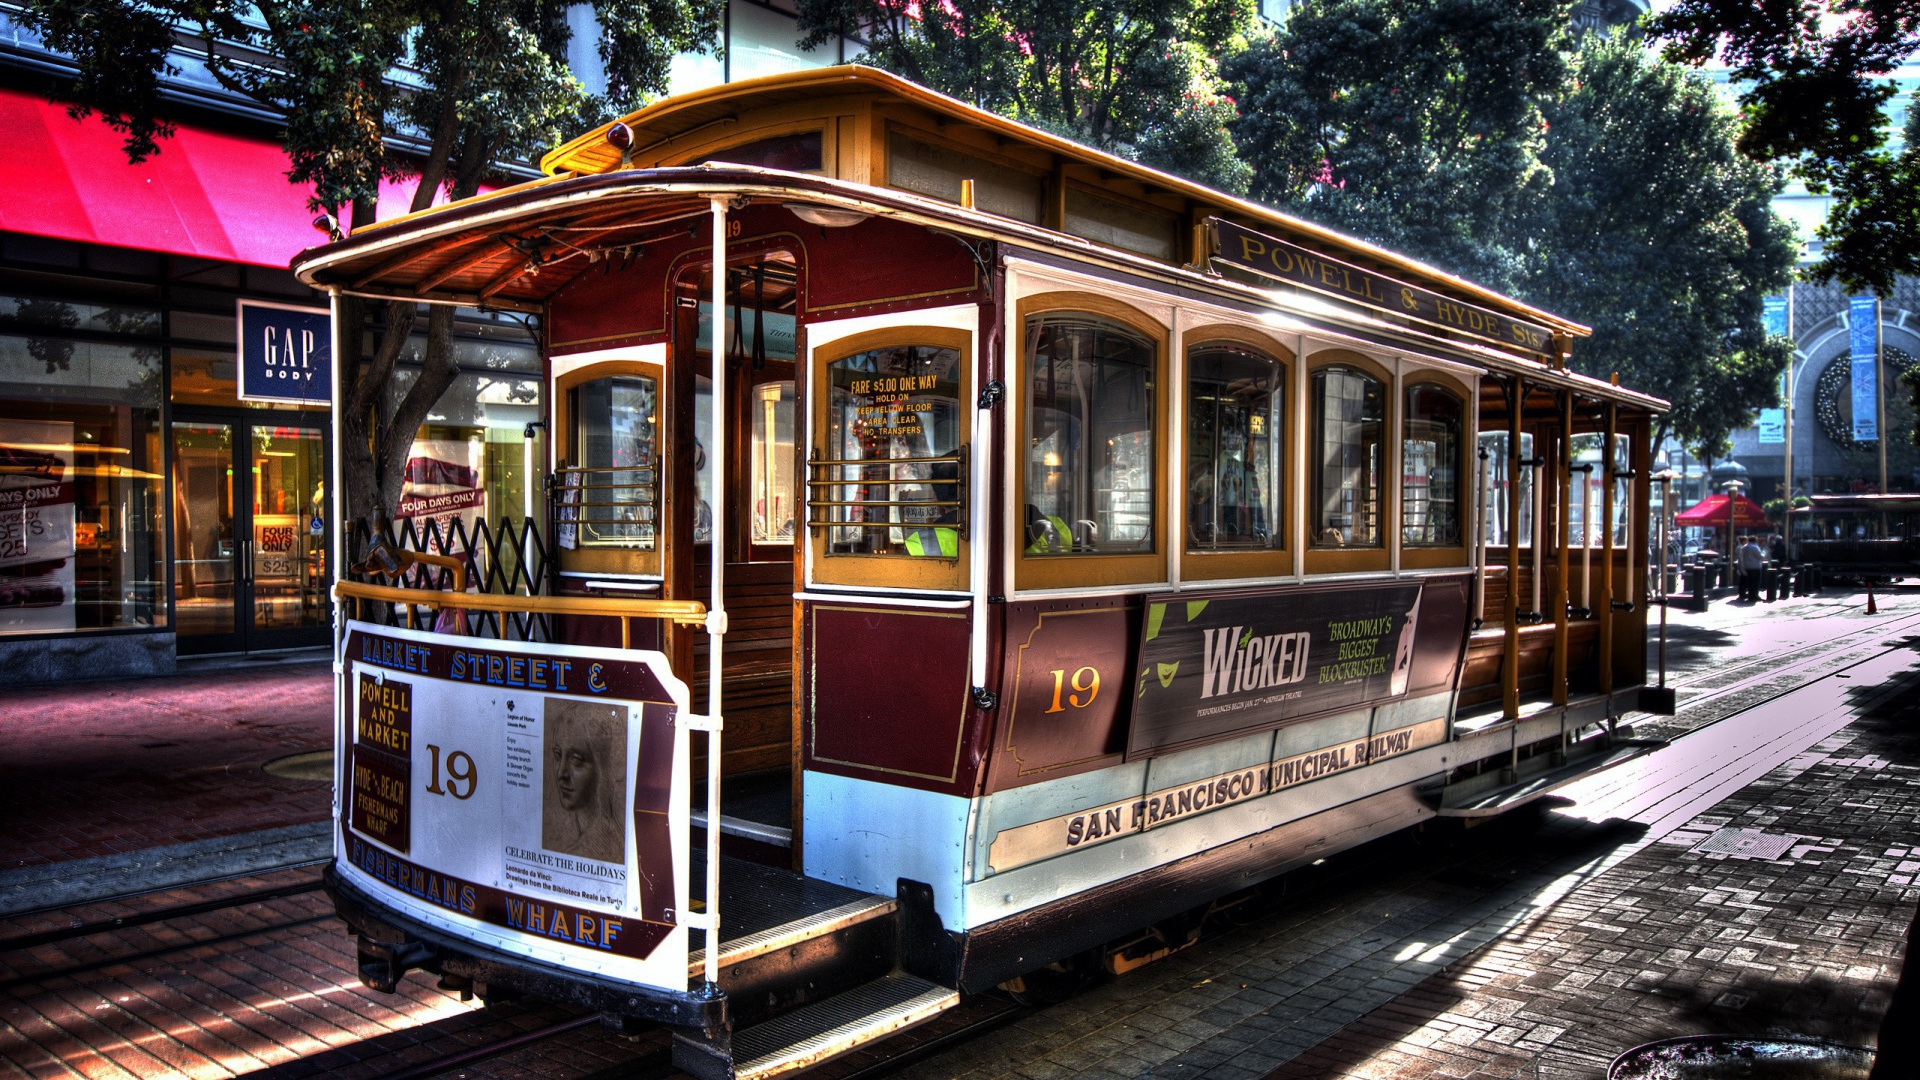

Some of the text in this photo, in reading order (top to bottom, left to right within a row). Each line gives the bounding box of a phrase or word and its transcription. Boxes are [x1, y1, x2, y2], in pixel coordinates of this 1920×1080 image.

[727, 220, 741, 238] 19
[1239, 235, 1544, 348] POWELL & HYDE Sts.
[264, 325, 314, 368] GAP
[265, 369, 312, 381] BODY
[851, 375, 937, 394] FARE $5.00 ONE WAY
[855, 403, 932, 415] KEEP YELLOW FLOOR
[876, 393, 909, 403] HOLD ON
[891, 415, 916, 424] CLEAR
[864, 426, 921, 436] NO TRANSFERS
[26, 485, 61, 500] ONLY
[402, 501, 427, 513] FOUR
[429, 496, 451, 508] DAYS
[453, 492, 475, 503] ONLY
[263, 527, 292, 535] FOUR
[263, 534, 292, 543] DAYS
[262, 542, 291, 551] ONLY
[263, 560, 290, 573] $25
[1338, 638, 1378, 660] BIGGEST
[361, 635, 431, 673] MARKET
[451, 650, 572, 691] STREET
[361, 680, 409, 713] POWELL
[1045, 667, 1101, 714] 19
[371, 705, 395, 727] AND
[524, 715, 535, 723] Honor
[360, 716, 410, 751] MARKET
[426, 744, 477, 800] 19
[355, 764, 371, 792] HYDE
[380, 774, 404, 806] BEACH
[1066, 729, 1413, 847] SAN FRANCISCO MUNICIPAL RAILWAY
[358, 792, 399, 825] FISHERMANS
[366, 812, 388, 837] WHARF
[505, 845, 626, 881] CELEBRATE THE HOLIDAYS
[505, 863, 552, 881] Leonardo da Vinci:
[352, 838, 623, 949] FISHERMANS WHARF
[505, 872, 529, 886] Drawings
[529, 878, 541, 889] from
[542, 881, 551, 891] the
[552, 884, 580, 898] Biblioteca
[581, 890, 599, 902] Reale
[599, 894, 606, 903] in
